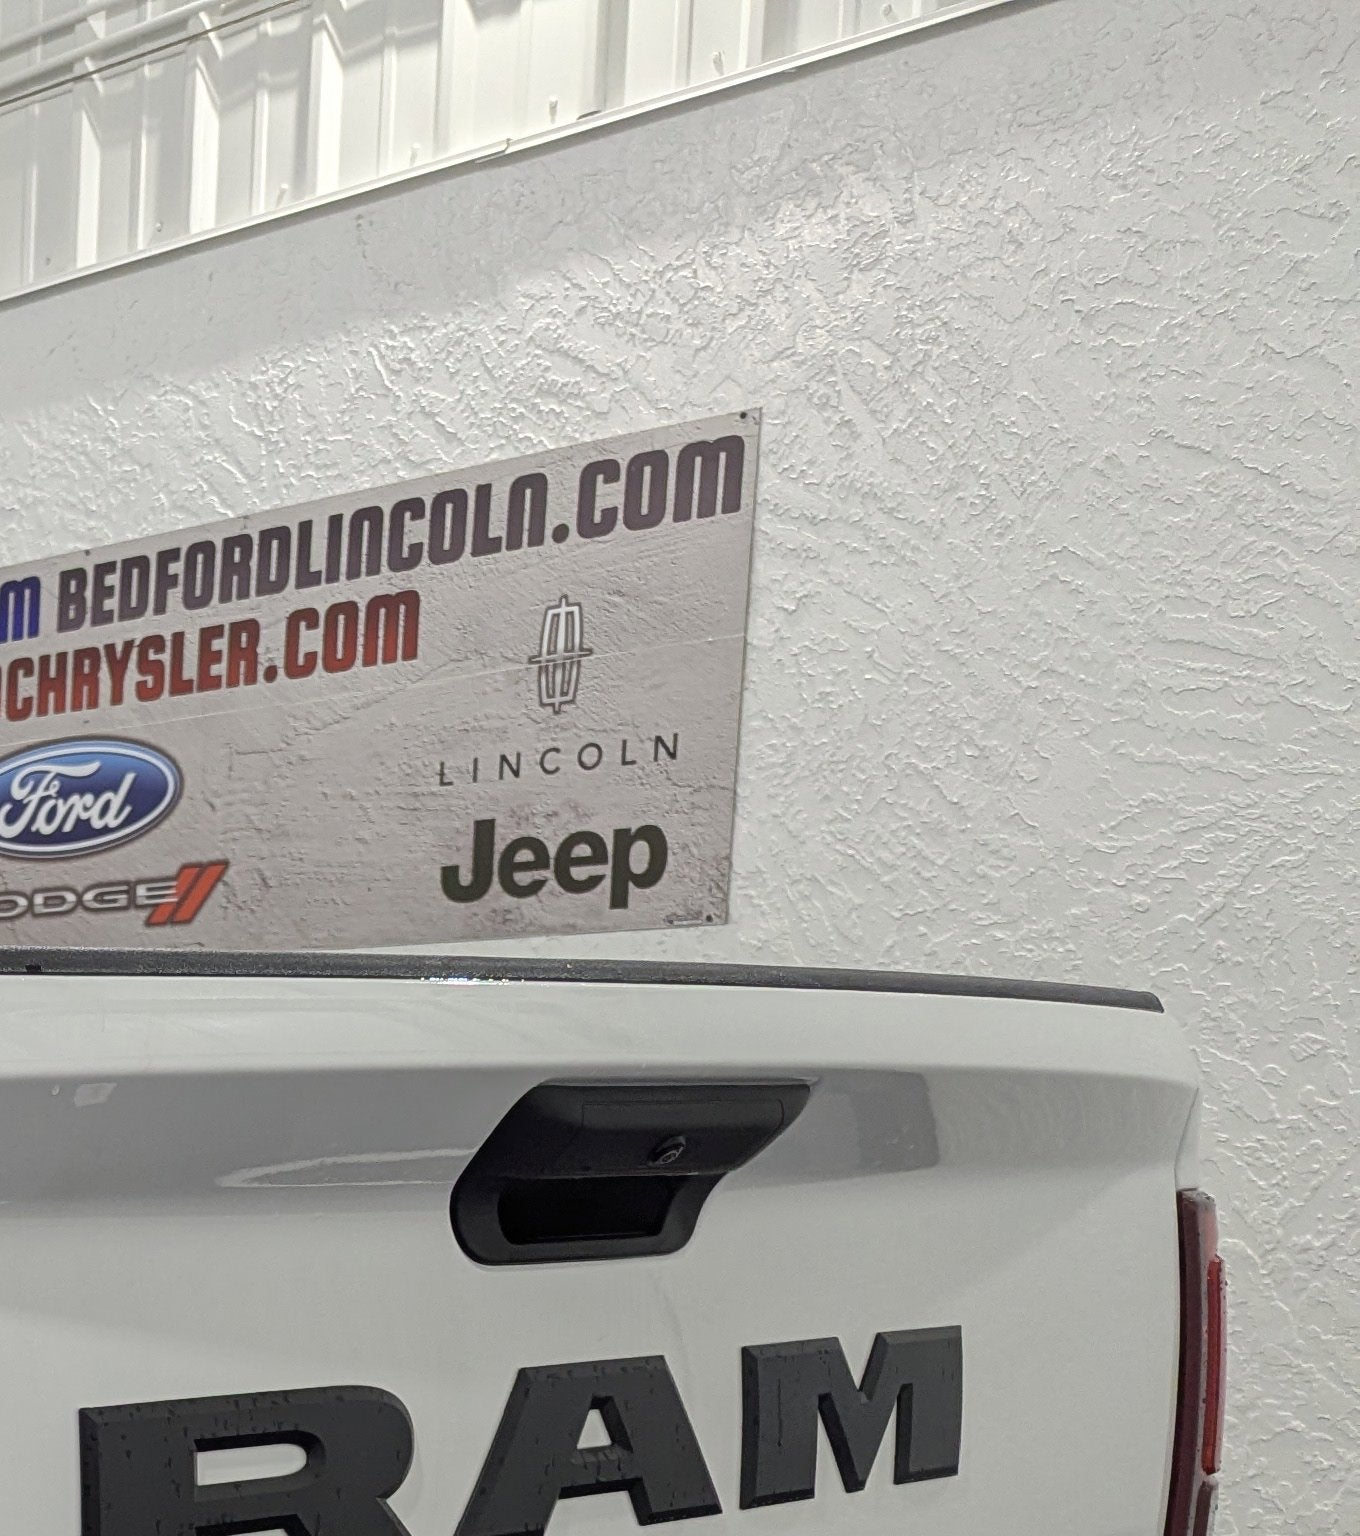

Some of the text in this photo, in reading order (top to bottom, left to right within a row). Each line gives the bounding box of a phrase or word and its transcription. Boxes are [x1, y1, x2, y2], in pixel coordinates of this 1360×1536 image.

[56, 434, 746, 634] BEDFORDLINCOLN.COM
[438, 733, 678, 787] LINCOLN
[441, 818, 668, 910] Jeep
